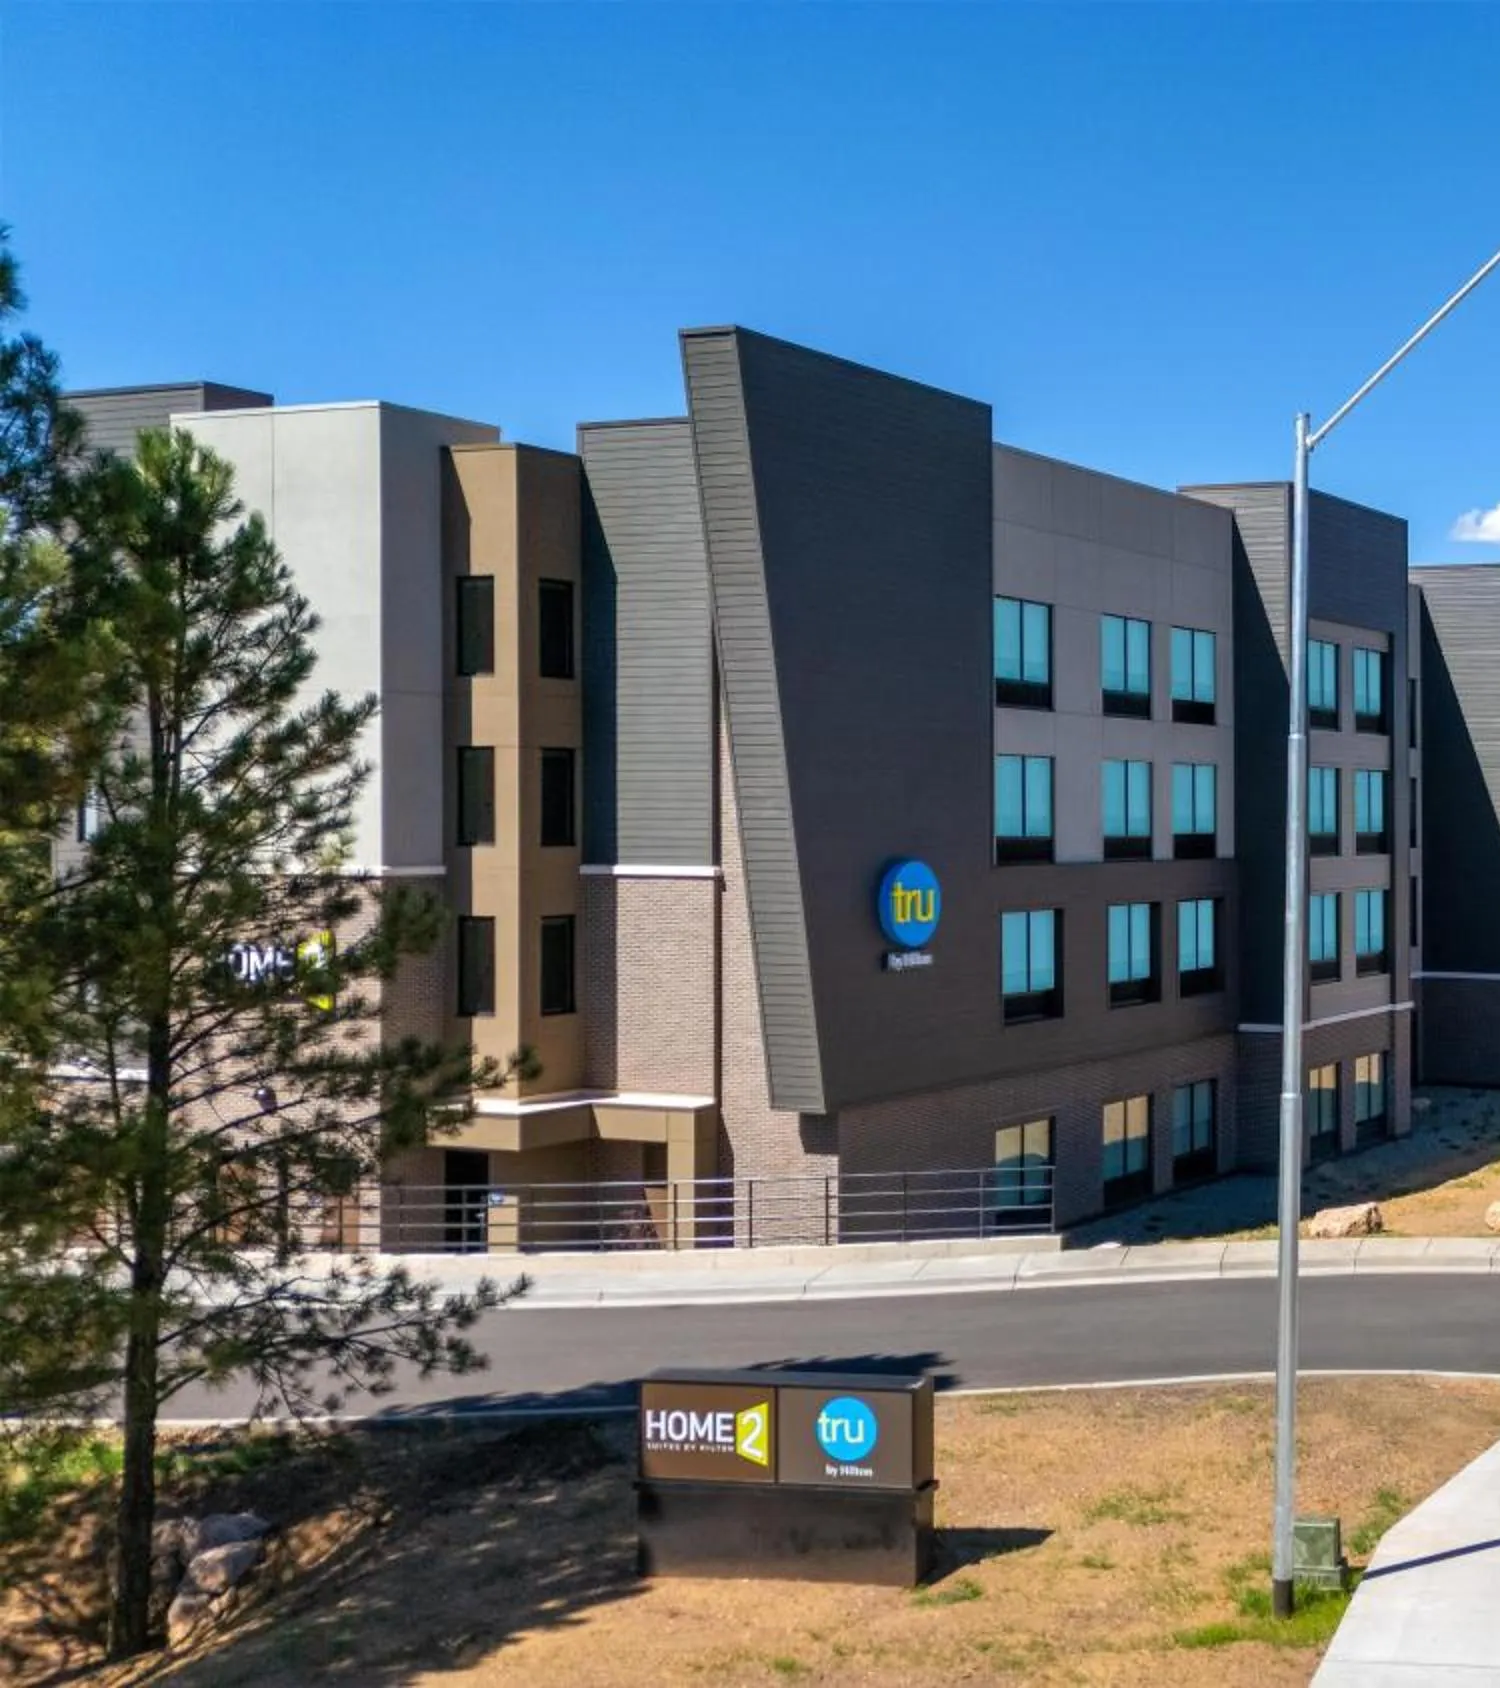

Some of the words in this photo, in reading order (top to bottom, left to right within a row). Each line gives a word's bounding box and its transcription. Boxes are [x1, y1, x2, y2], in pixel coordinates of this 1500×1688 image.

[892, 881, 935, 923] tru
[645, 1409, 735, 1442] HOME
[818, 1410, 865, 1444] tru
